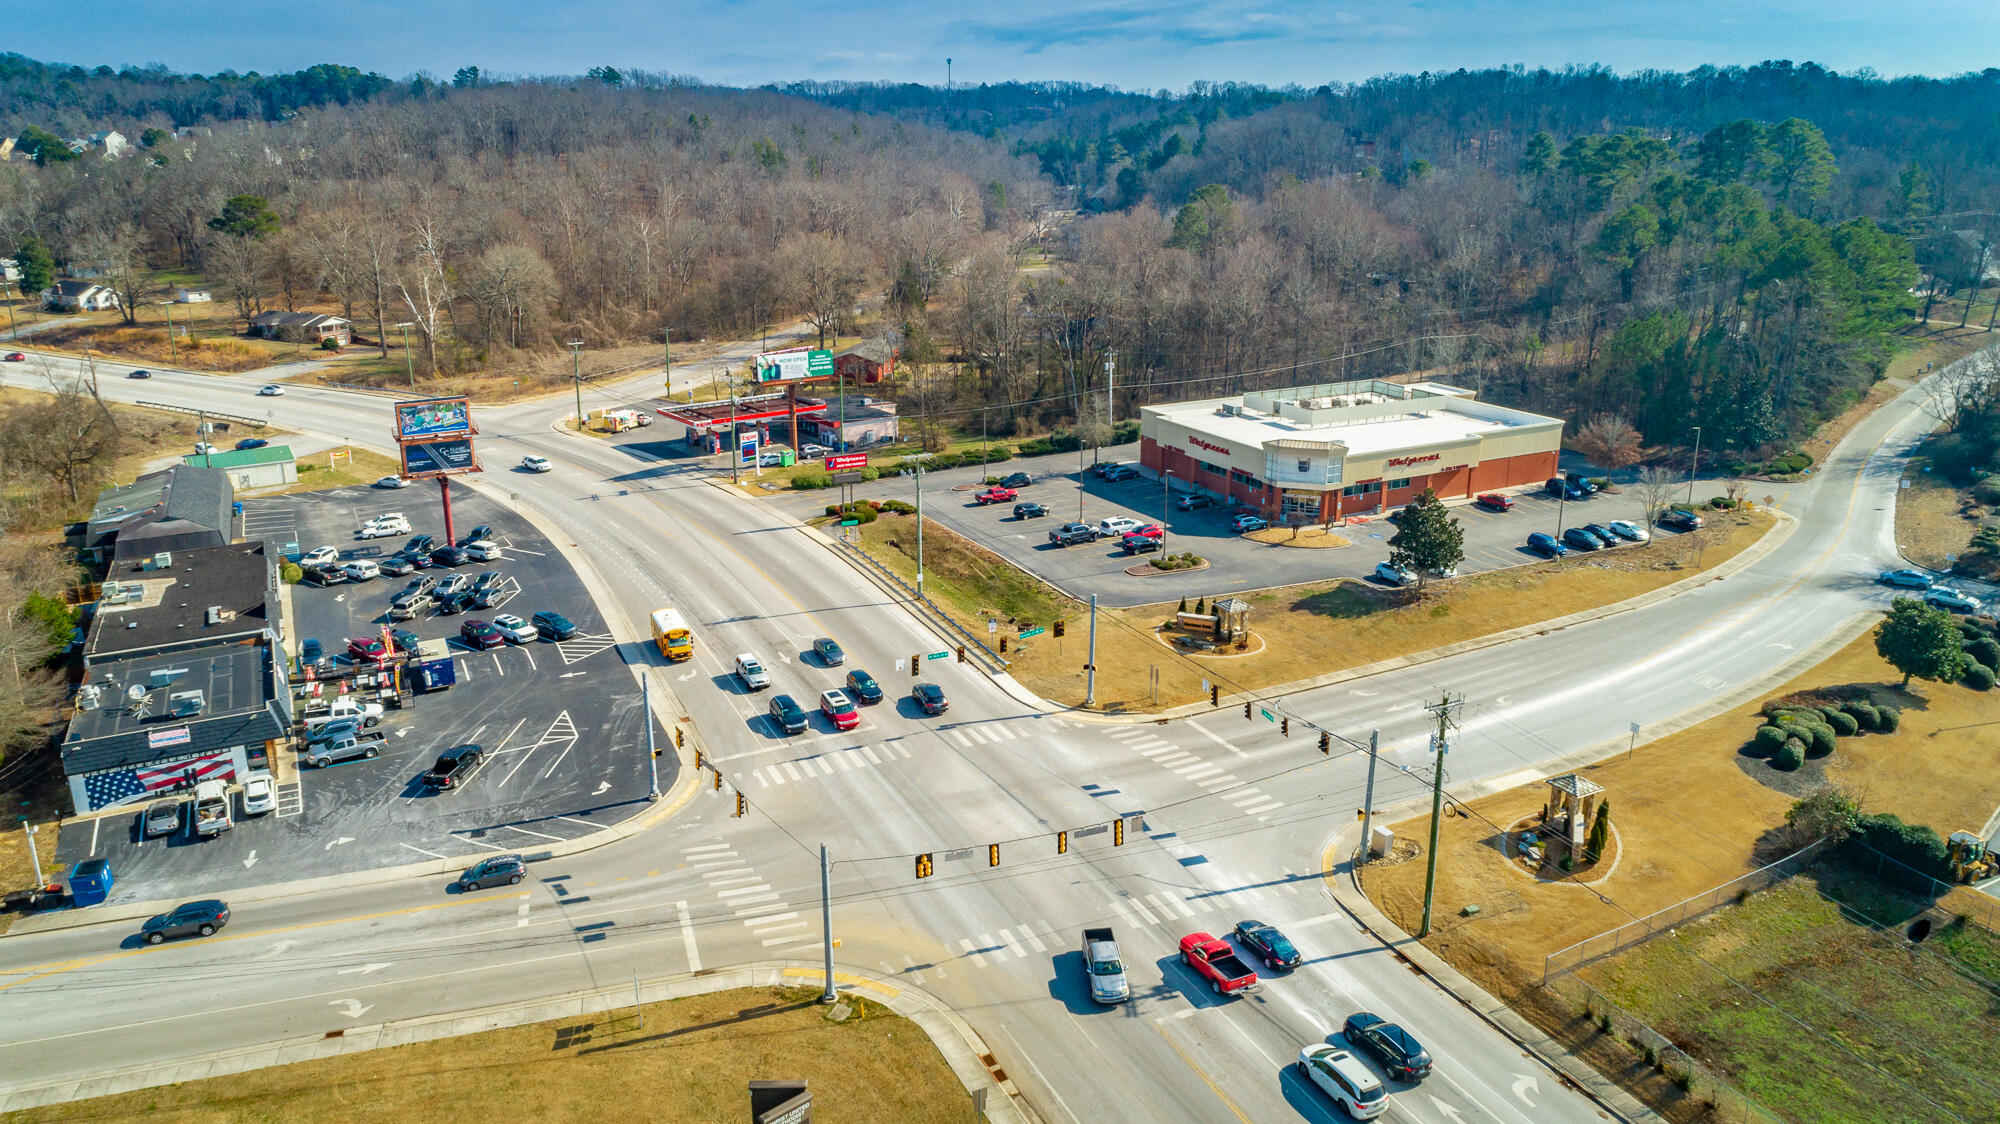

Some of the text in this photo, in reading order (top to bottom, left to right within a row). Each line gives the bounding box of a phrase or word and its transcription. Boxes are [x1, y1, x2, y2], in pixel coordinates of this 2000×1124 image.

[1188, 435, 1231, 456] Walgreens
[1388, 453, 1441, 467] Walgreens
[789, 1102, 810, 1117] UNITED
